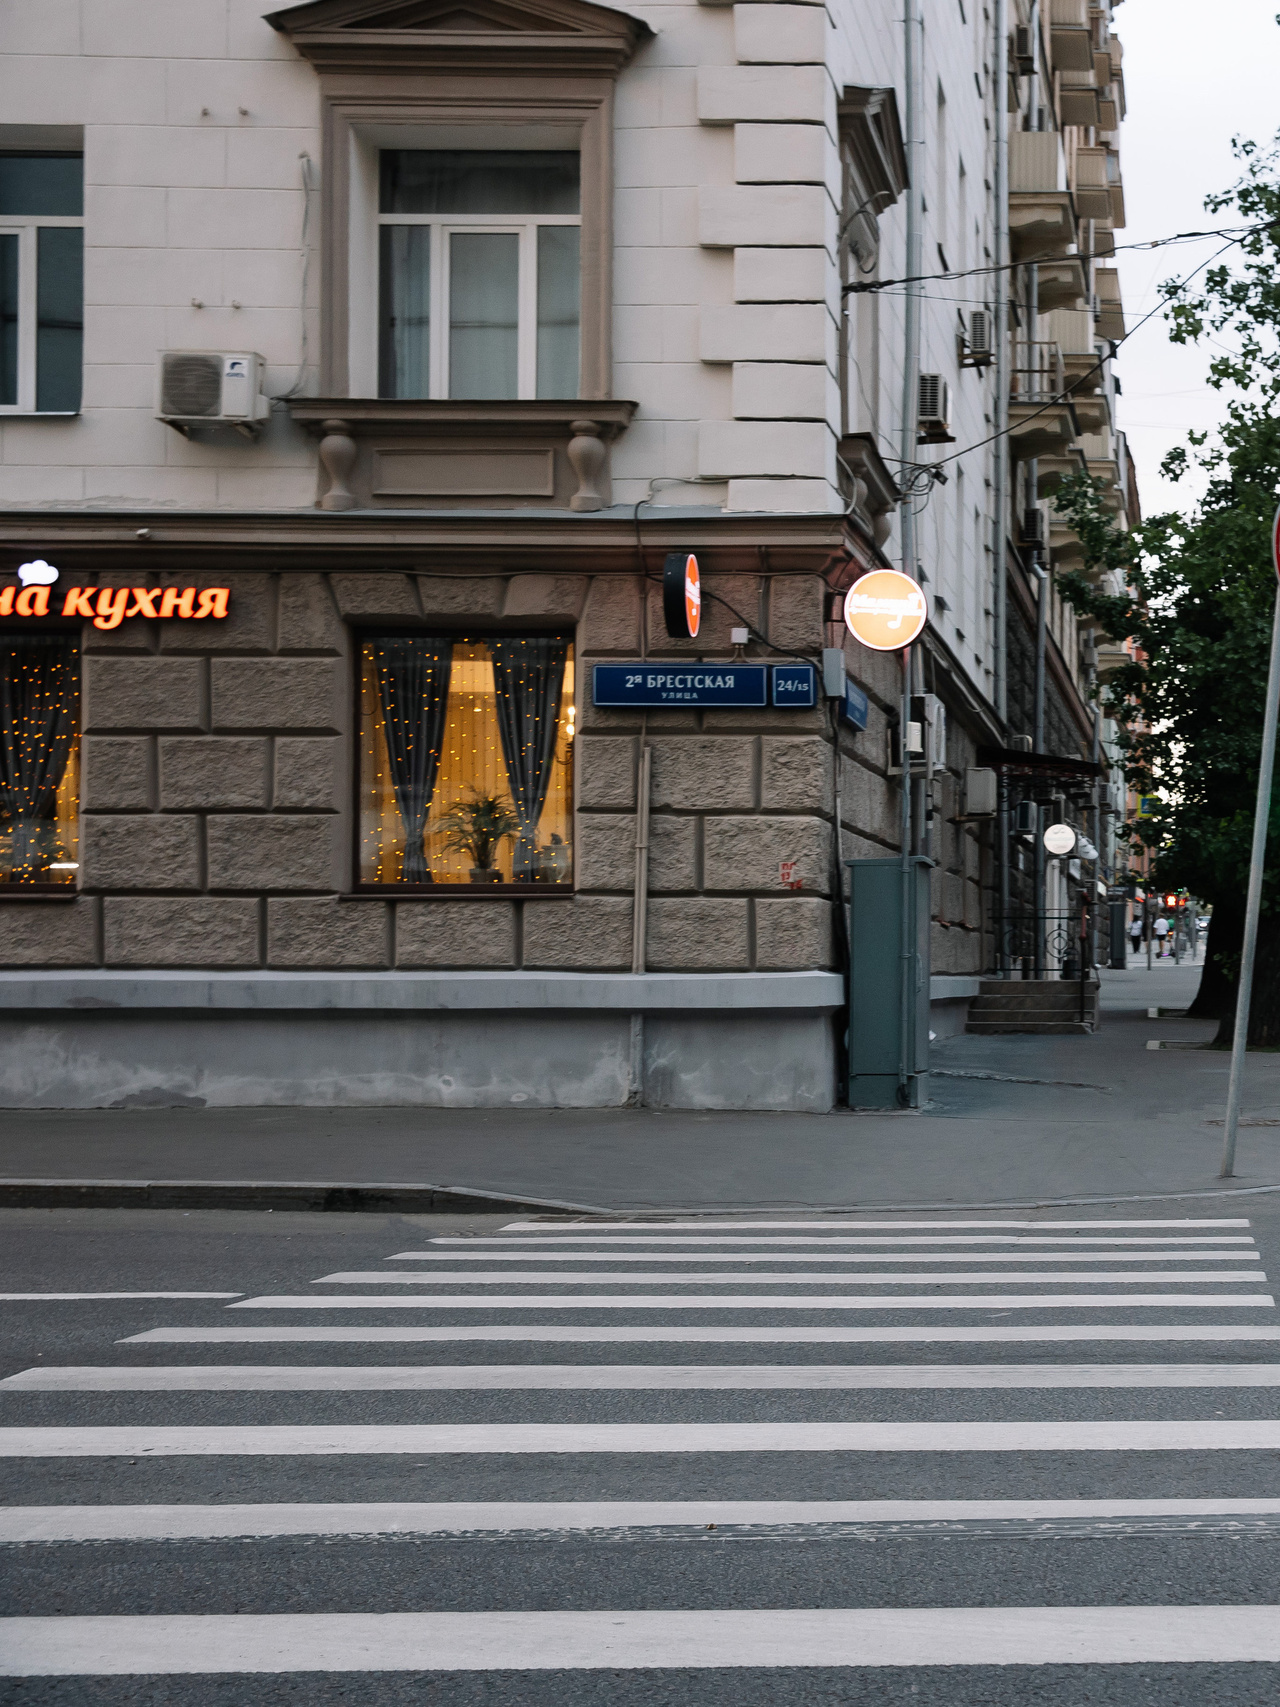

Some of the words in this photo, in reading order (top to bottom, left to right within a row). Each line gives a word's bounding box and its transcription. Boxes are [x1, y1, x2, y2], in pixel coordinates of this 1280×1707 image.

[61, 587, 230, 630] кухня
[647, 675, 734, 688] БРЕСТСКАЯ
[777, 680, 809, 691] 24/15
